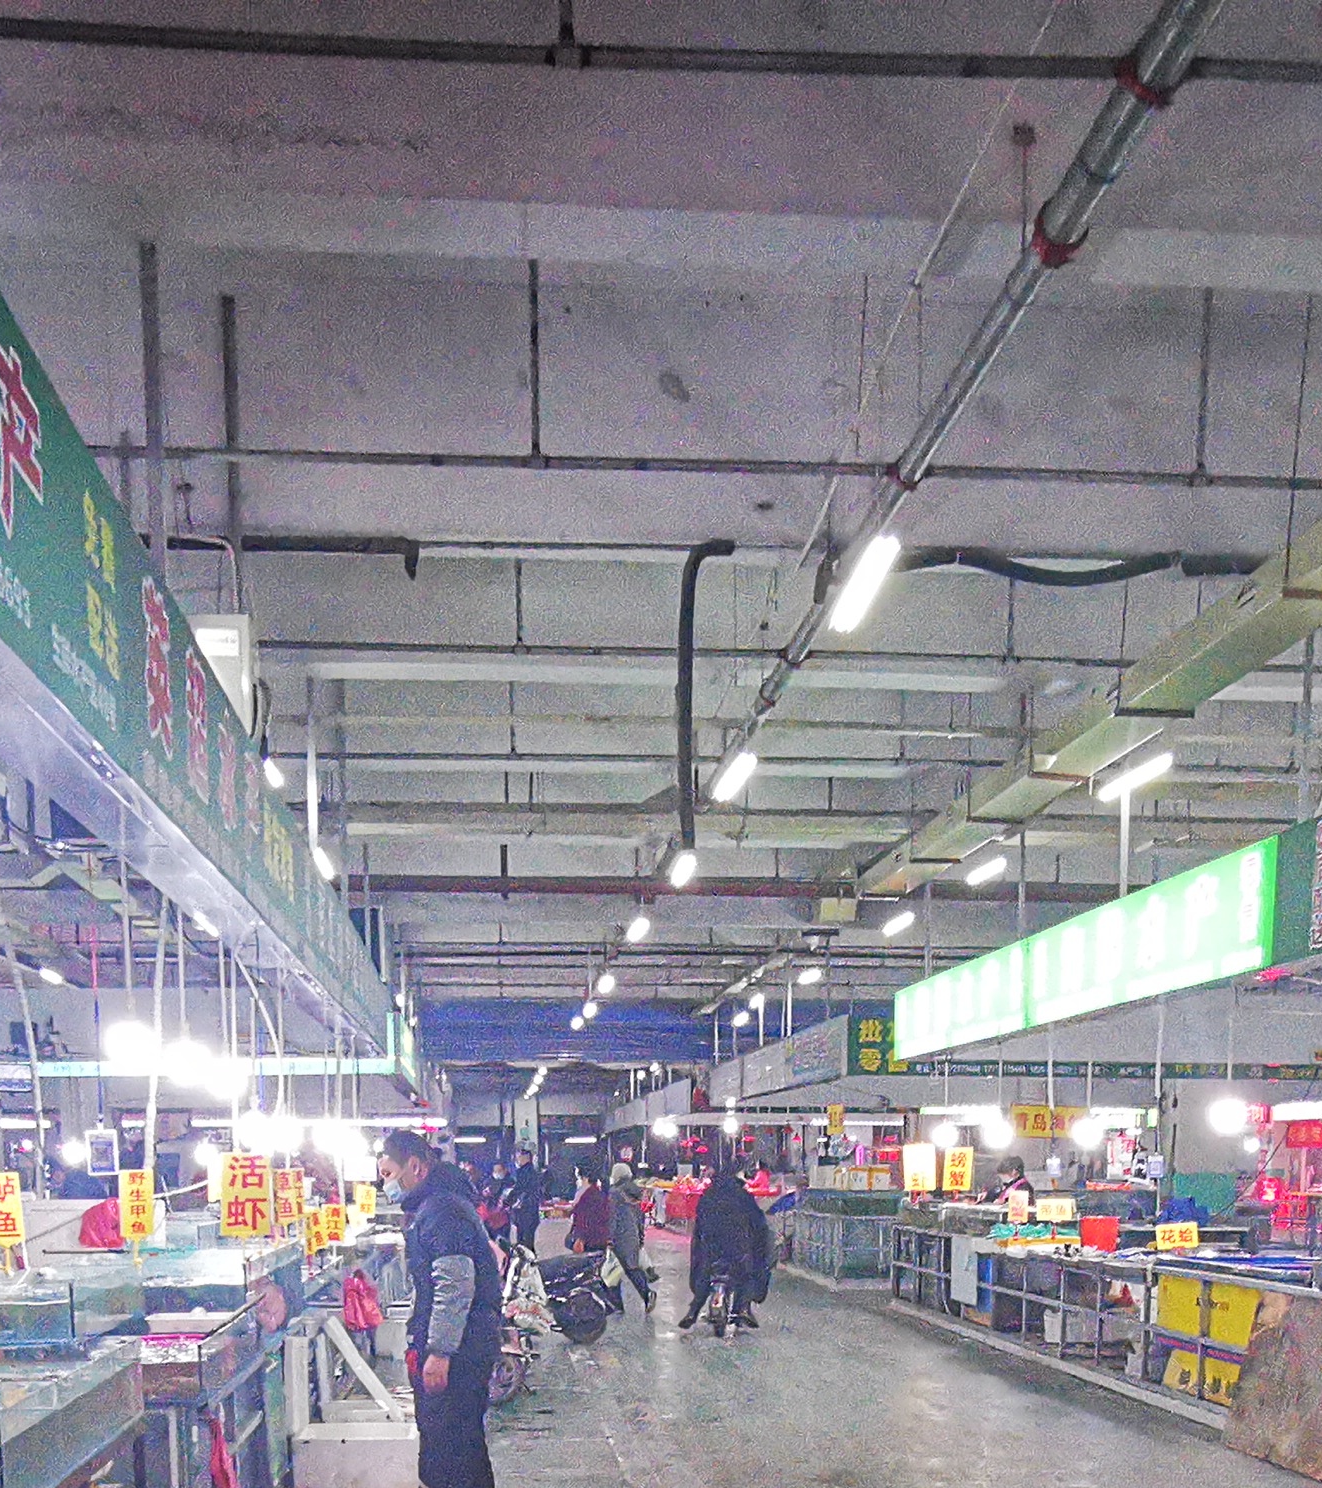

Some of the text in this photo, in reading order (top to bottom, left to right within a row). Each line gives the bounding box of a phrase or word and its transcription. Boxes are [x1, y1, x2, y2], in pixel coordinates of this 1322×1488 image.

[127, 1171, 147, 1235] 野生甲鱼
[226, 1154, 269, 1231] 活虾
